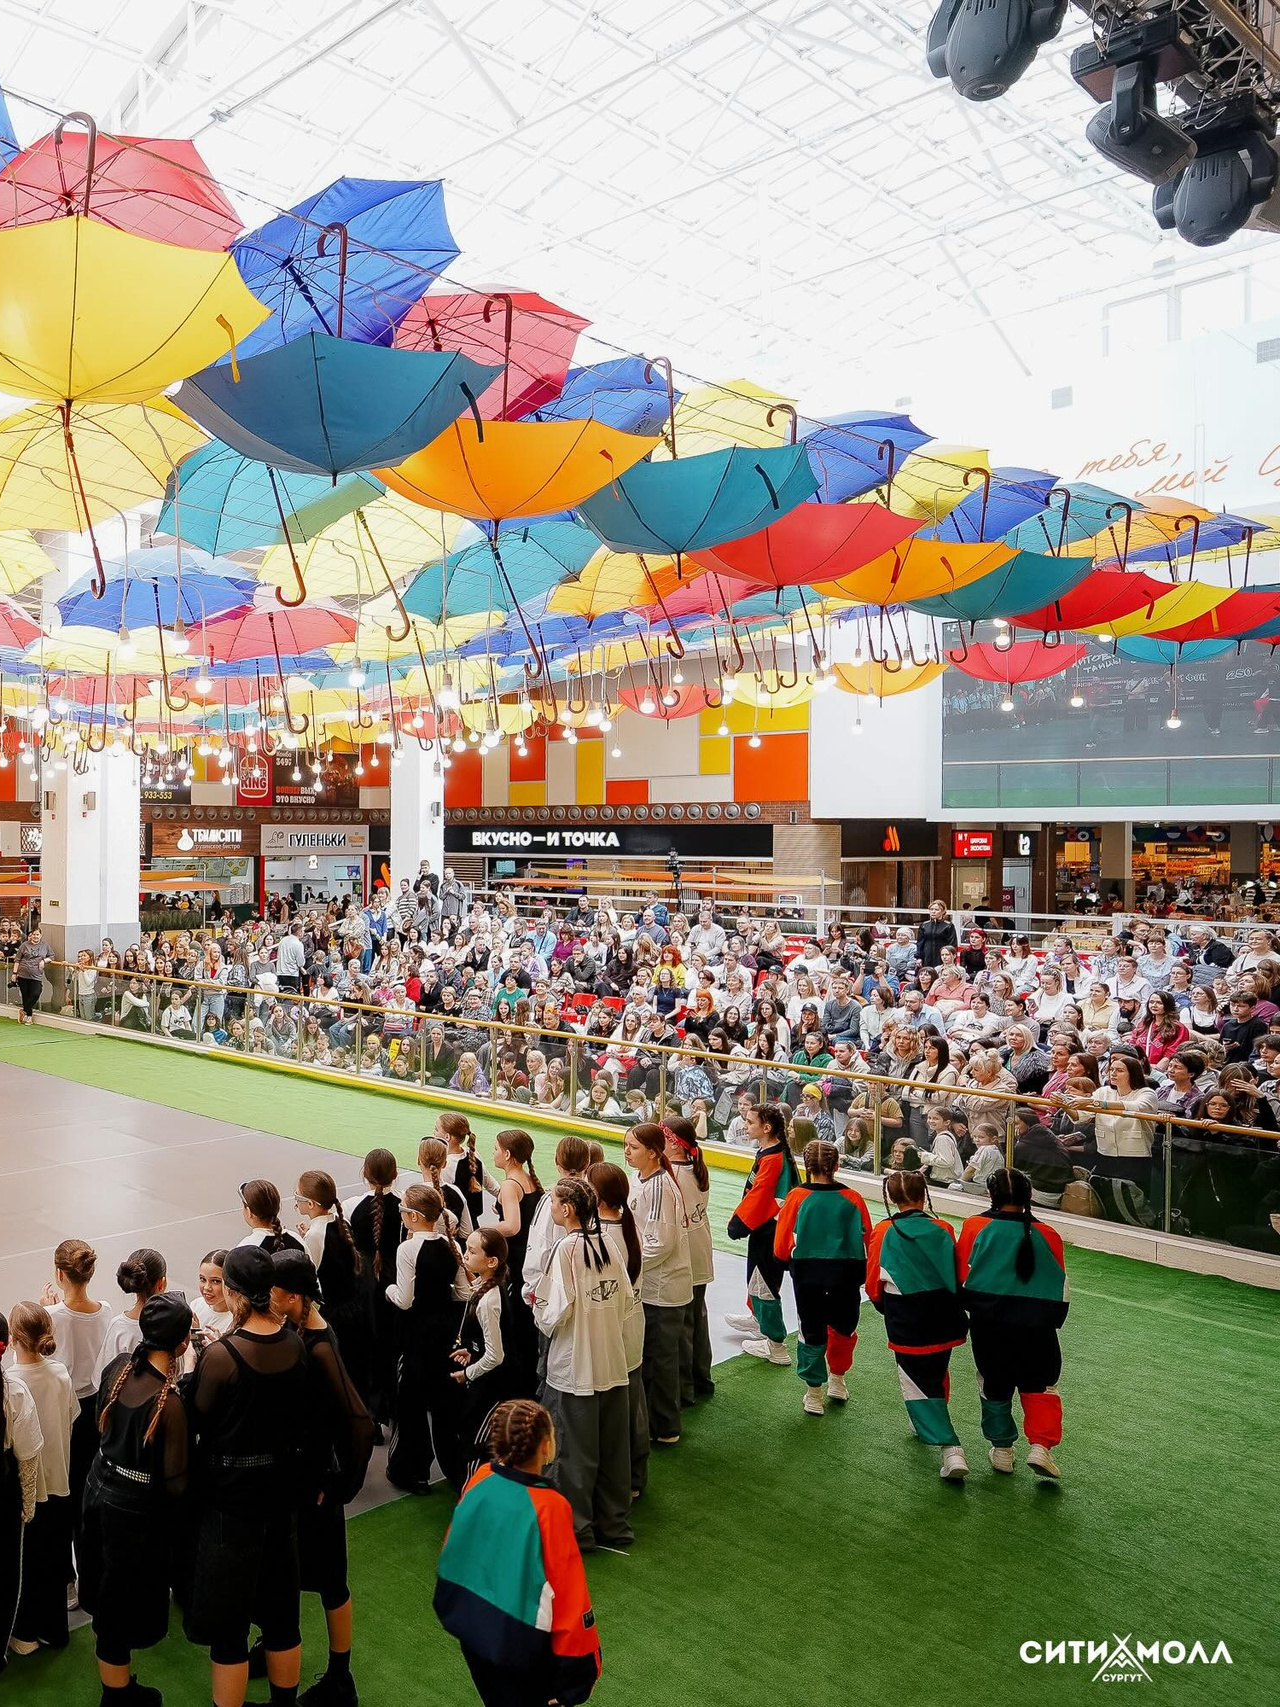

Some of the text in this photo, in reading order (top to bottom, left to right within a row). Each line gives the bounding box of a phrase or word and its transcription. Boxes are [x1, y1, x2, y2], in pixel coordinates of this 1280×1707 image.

[1075, 439, 1182, 479] тебя,
[1134, 454, 1233, 497] мой
[241, 777, 267, 788] KING
[144, 791, 173, 799] 933-553
[288, 833, 346, 847] ГУЛЕНЬКИ
[561, 831, 620, 847] ТОЧКА
